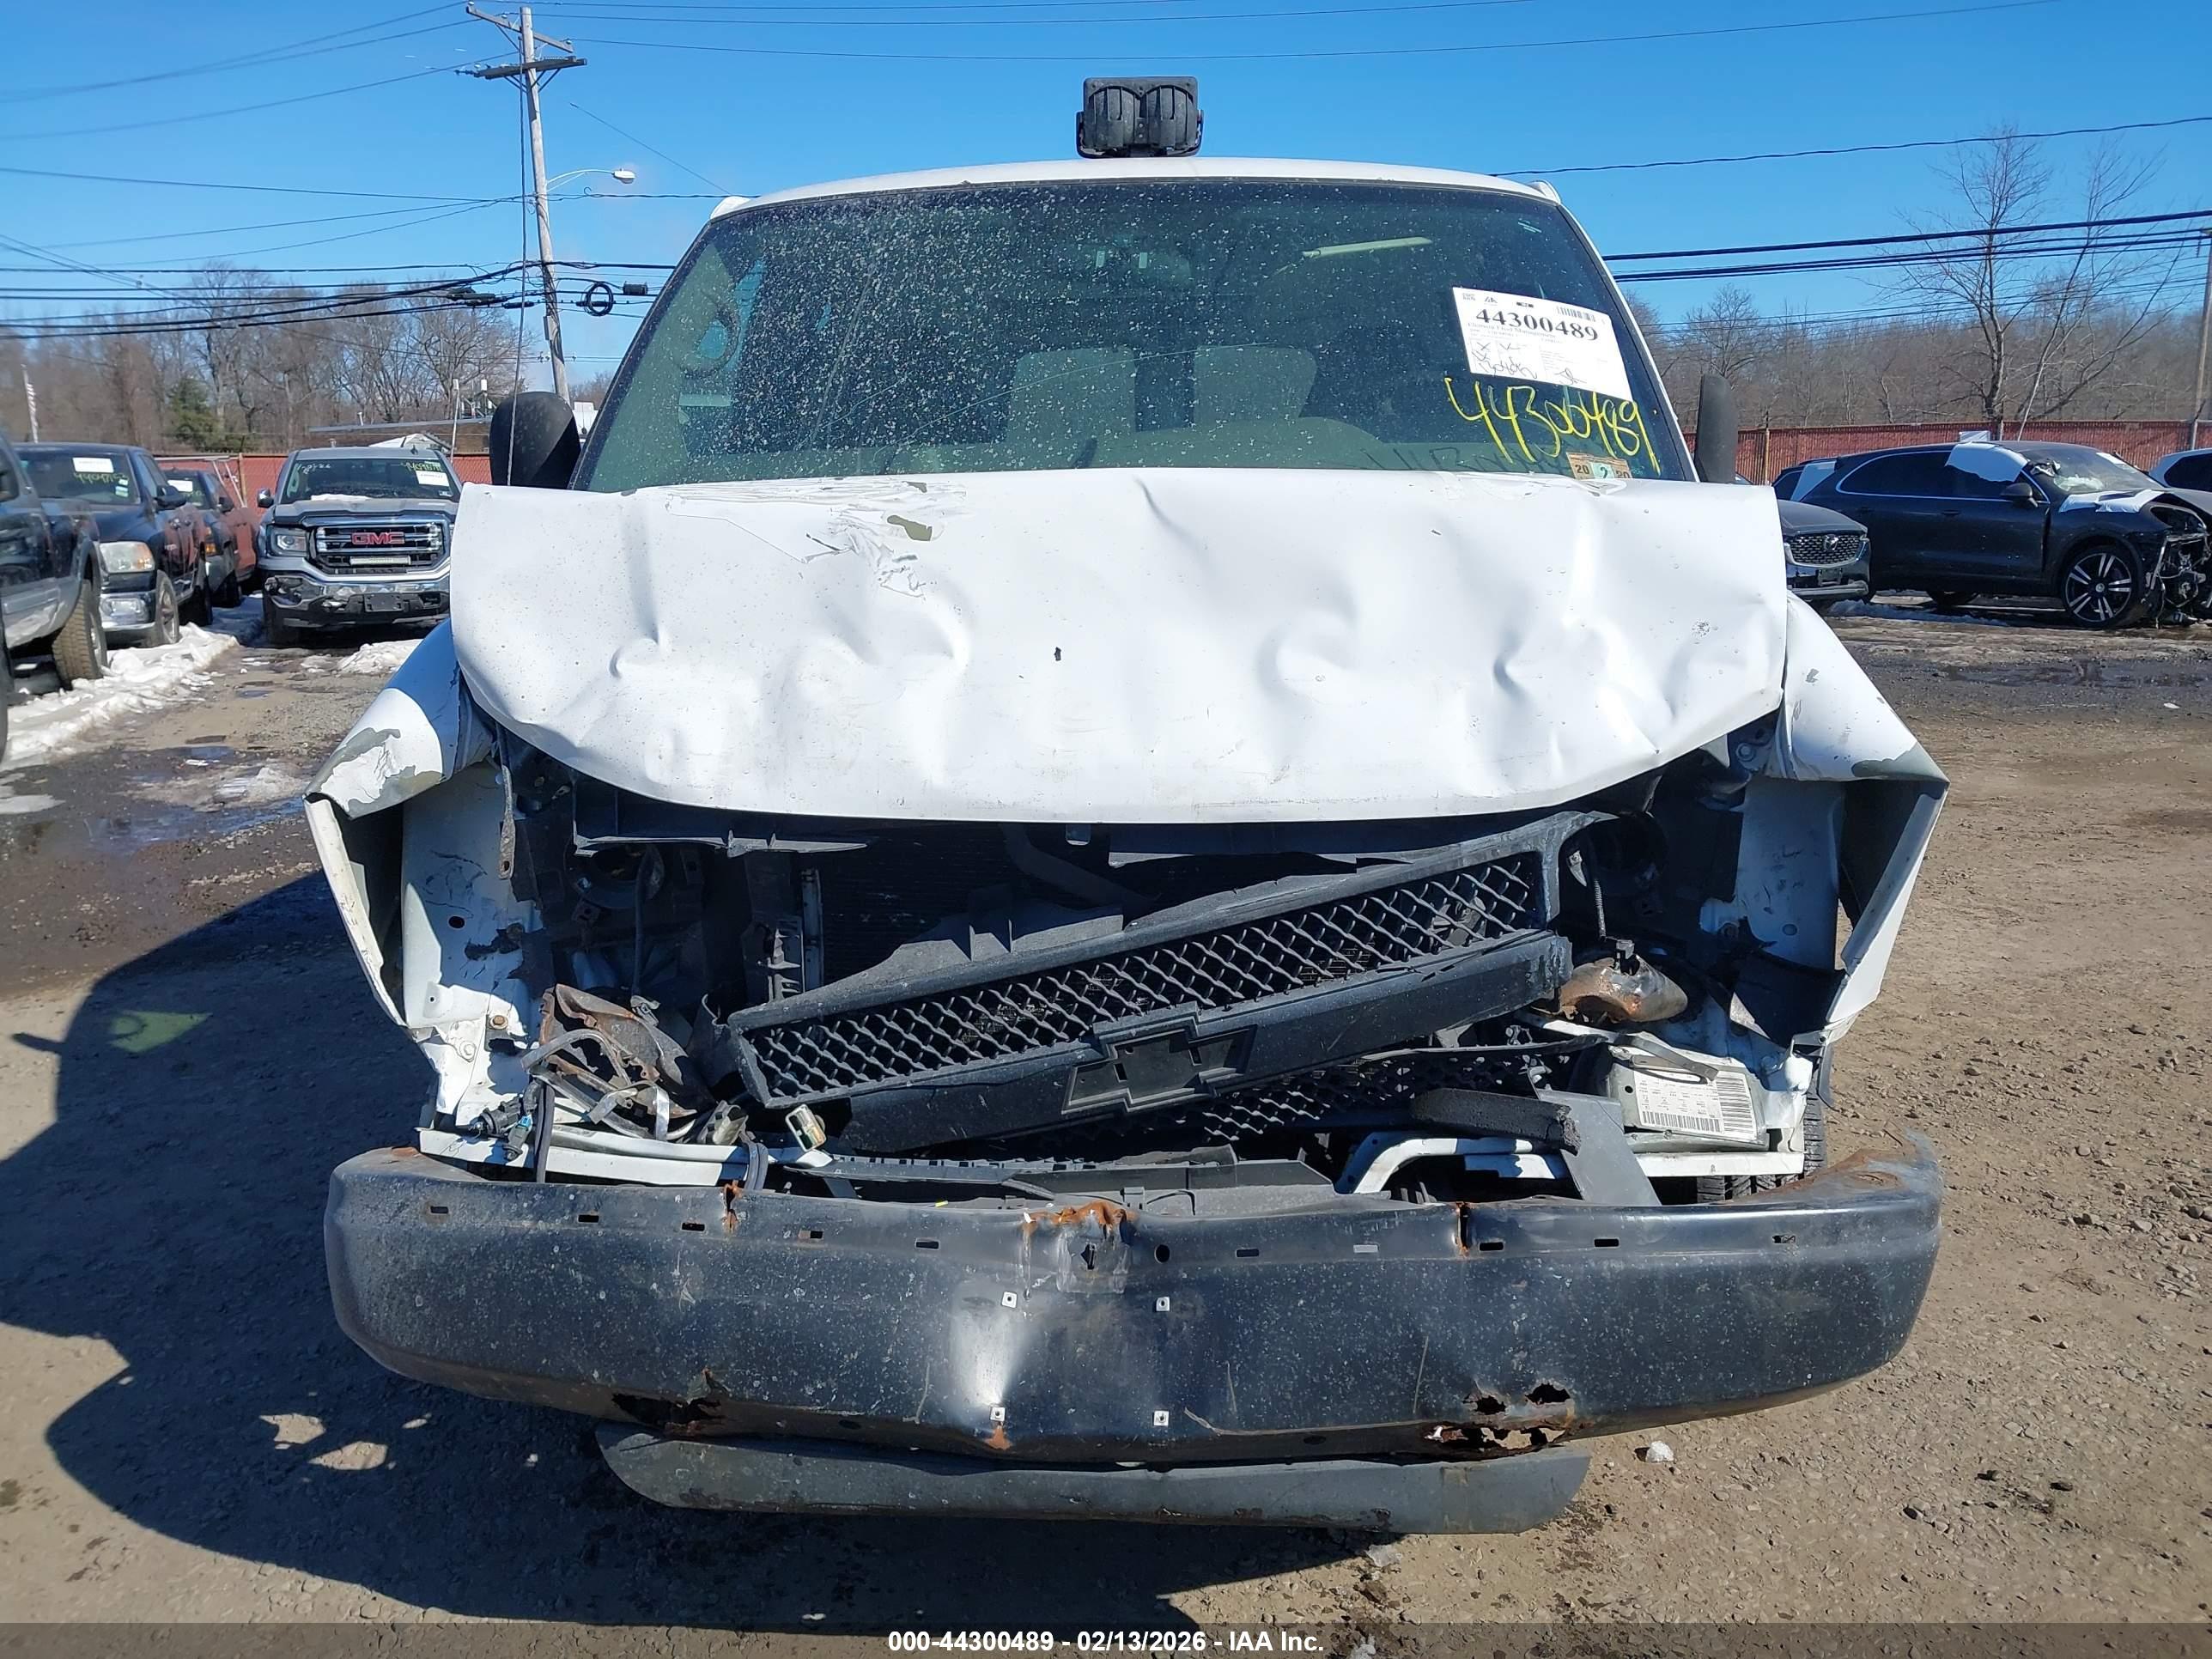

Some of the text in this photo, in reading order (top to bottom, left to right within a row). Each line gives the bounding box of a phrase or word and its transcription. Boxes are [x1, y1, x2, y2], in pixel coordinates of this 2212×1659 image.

[1476, 309, 1598, 341] 44300489
[1443, 377, 1661, 477] 44300489
[1575, 465, 1589, 474] 20
[351, 532, 405, 545] GMC
